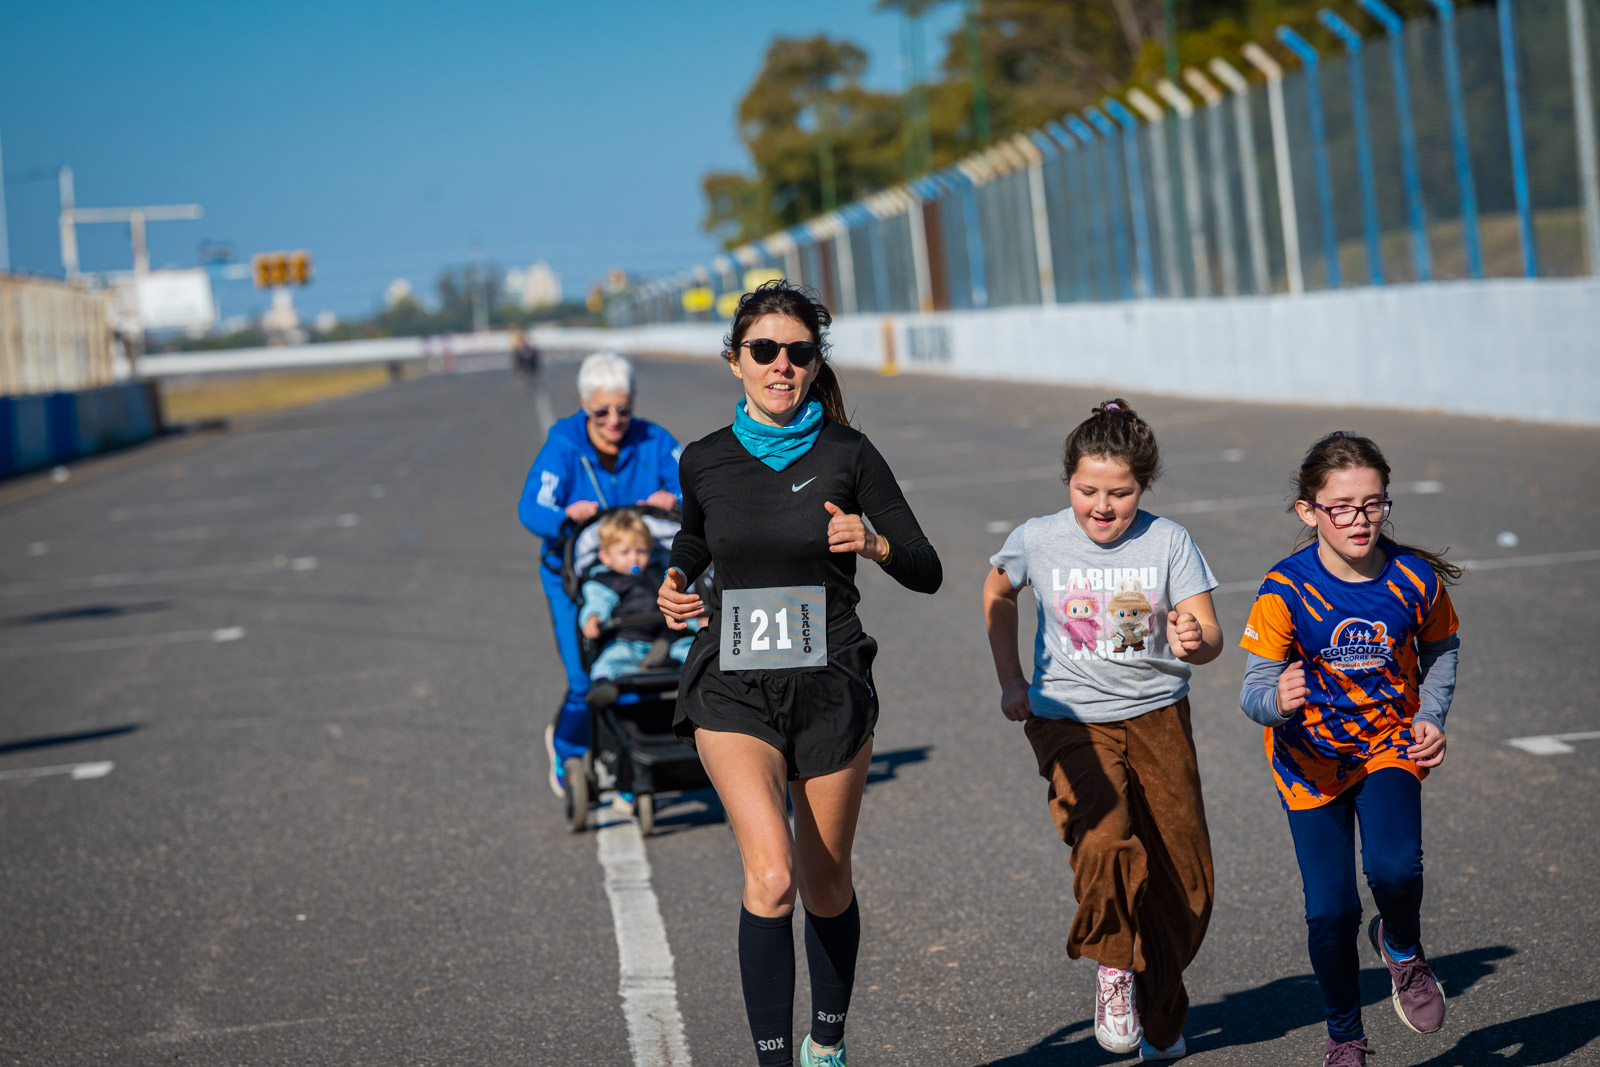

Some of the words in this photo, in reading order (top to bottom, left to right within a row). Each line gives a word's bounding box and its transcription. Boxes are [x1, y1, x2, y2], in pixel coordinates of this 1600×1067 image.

[732, 606, 742, 656] TIEMPO
[750, 607, 792, 651] 21
[800, 604, 812, 654] EXACTO
[1372, 623, 1385, 643] 2
[1343, 654, 1370, 662] CORRE
[817, 1010, 845, 1023] SOX
[757, 1037, 785, 1051] SOX
